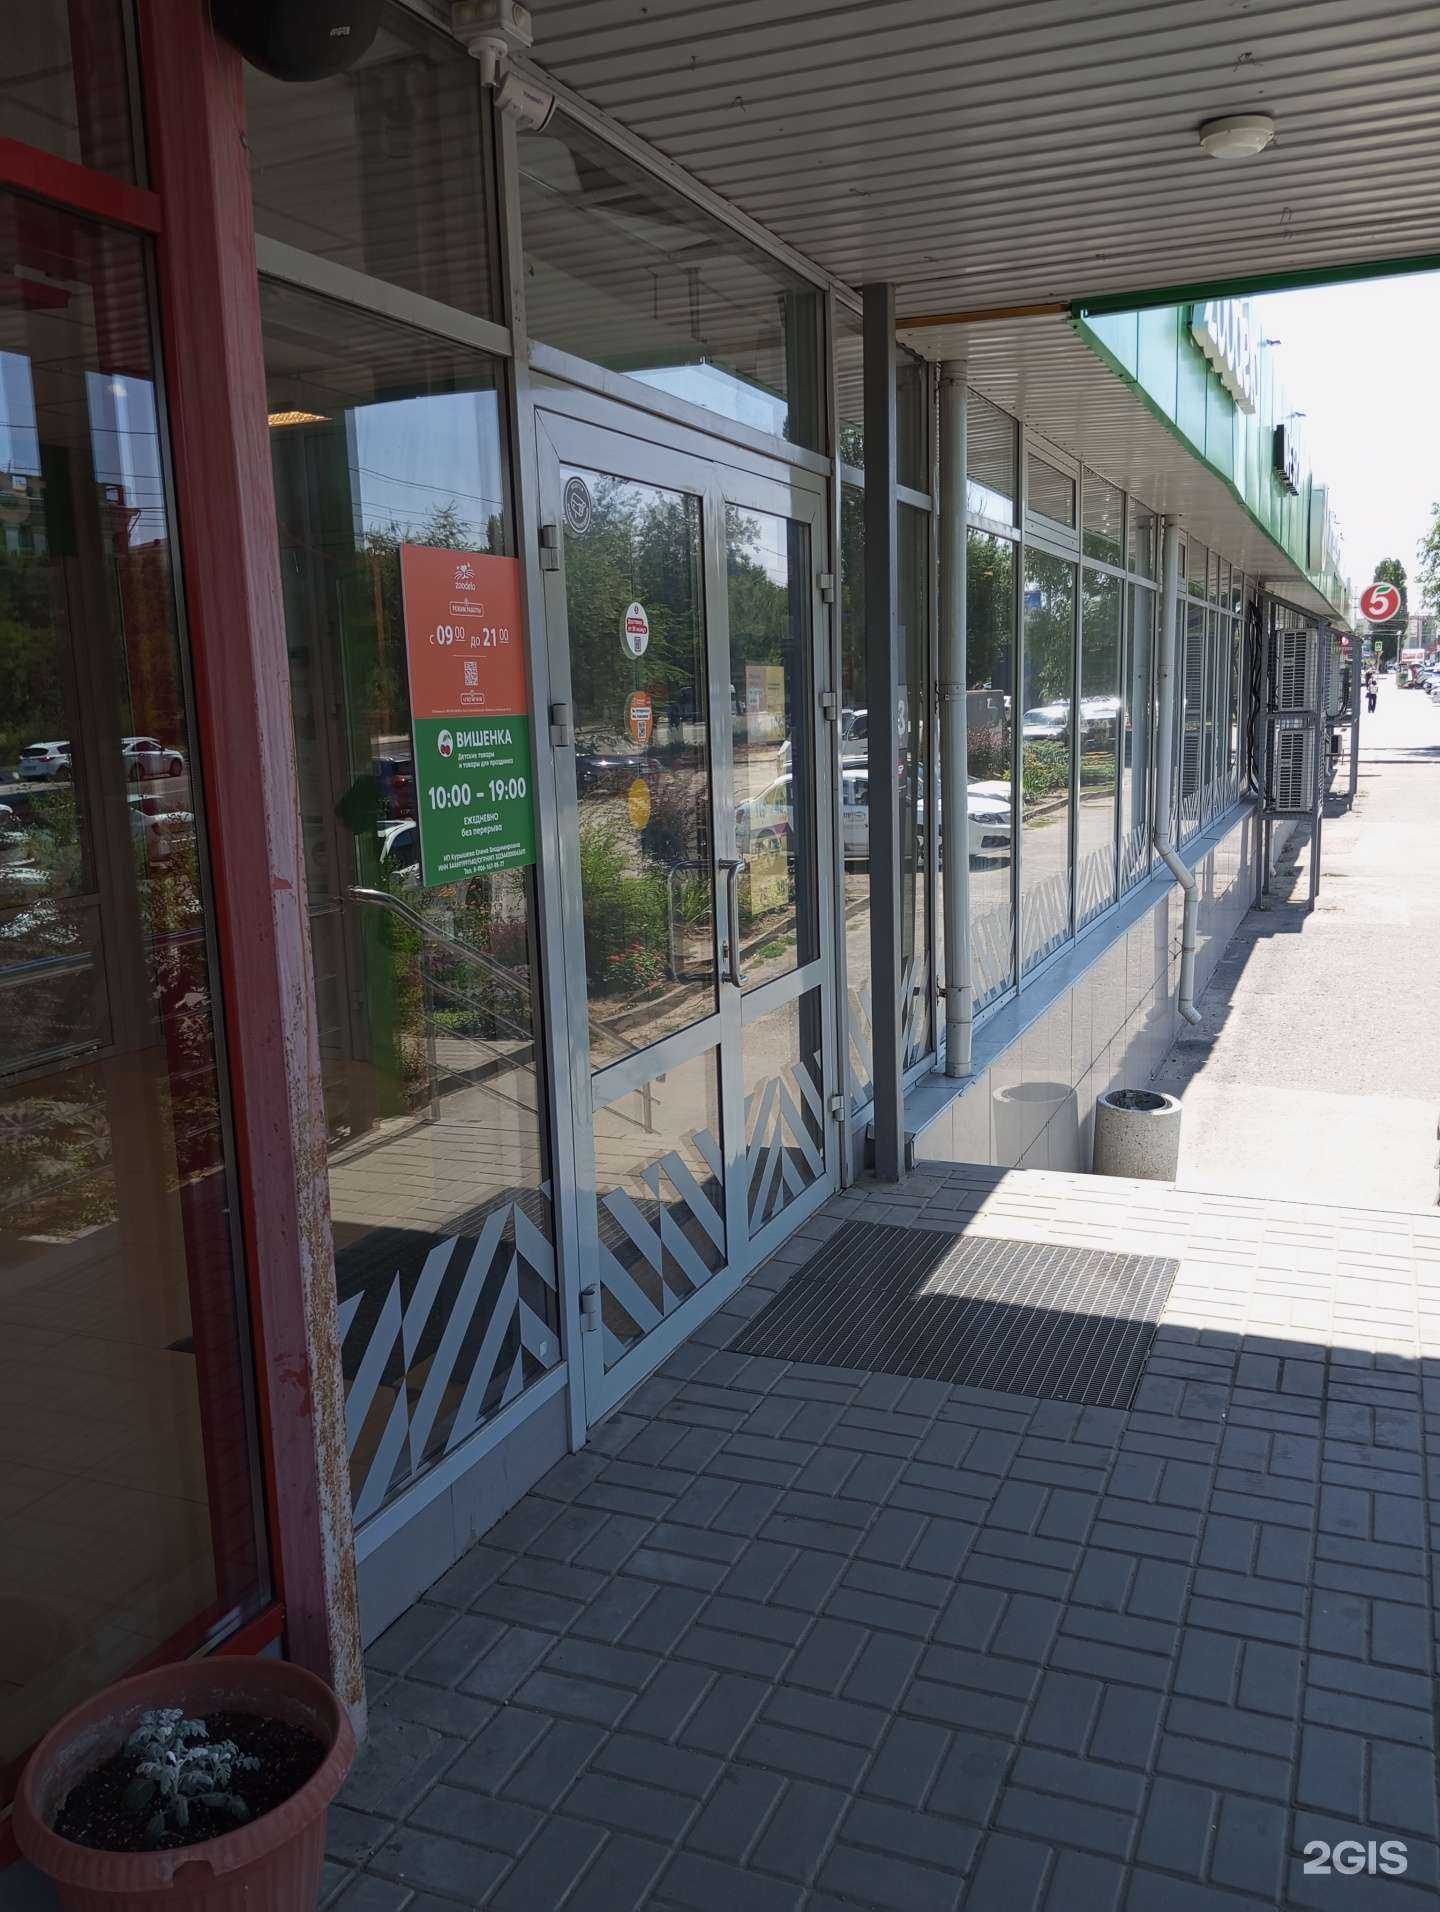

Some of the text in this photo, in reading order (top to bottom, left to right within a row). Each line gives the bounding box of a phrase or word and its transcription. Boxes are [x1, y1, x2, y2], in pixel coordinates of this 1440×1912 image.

[1368, 584, 1391, 615] 5
[470, 636, 481, 649] до
[456, 729, 512, 748] ВИШЕНКА
[428, 783, 471, 810] 10:00
[488, 777, 526, 802] 19:00
[464, 812, 499, 825] ЕЖЕДНЕВНО
[461, 824, 503, 838] без перерыва
